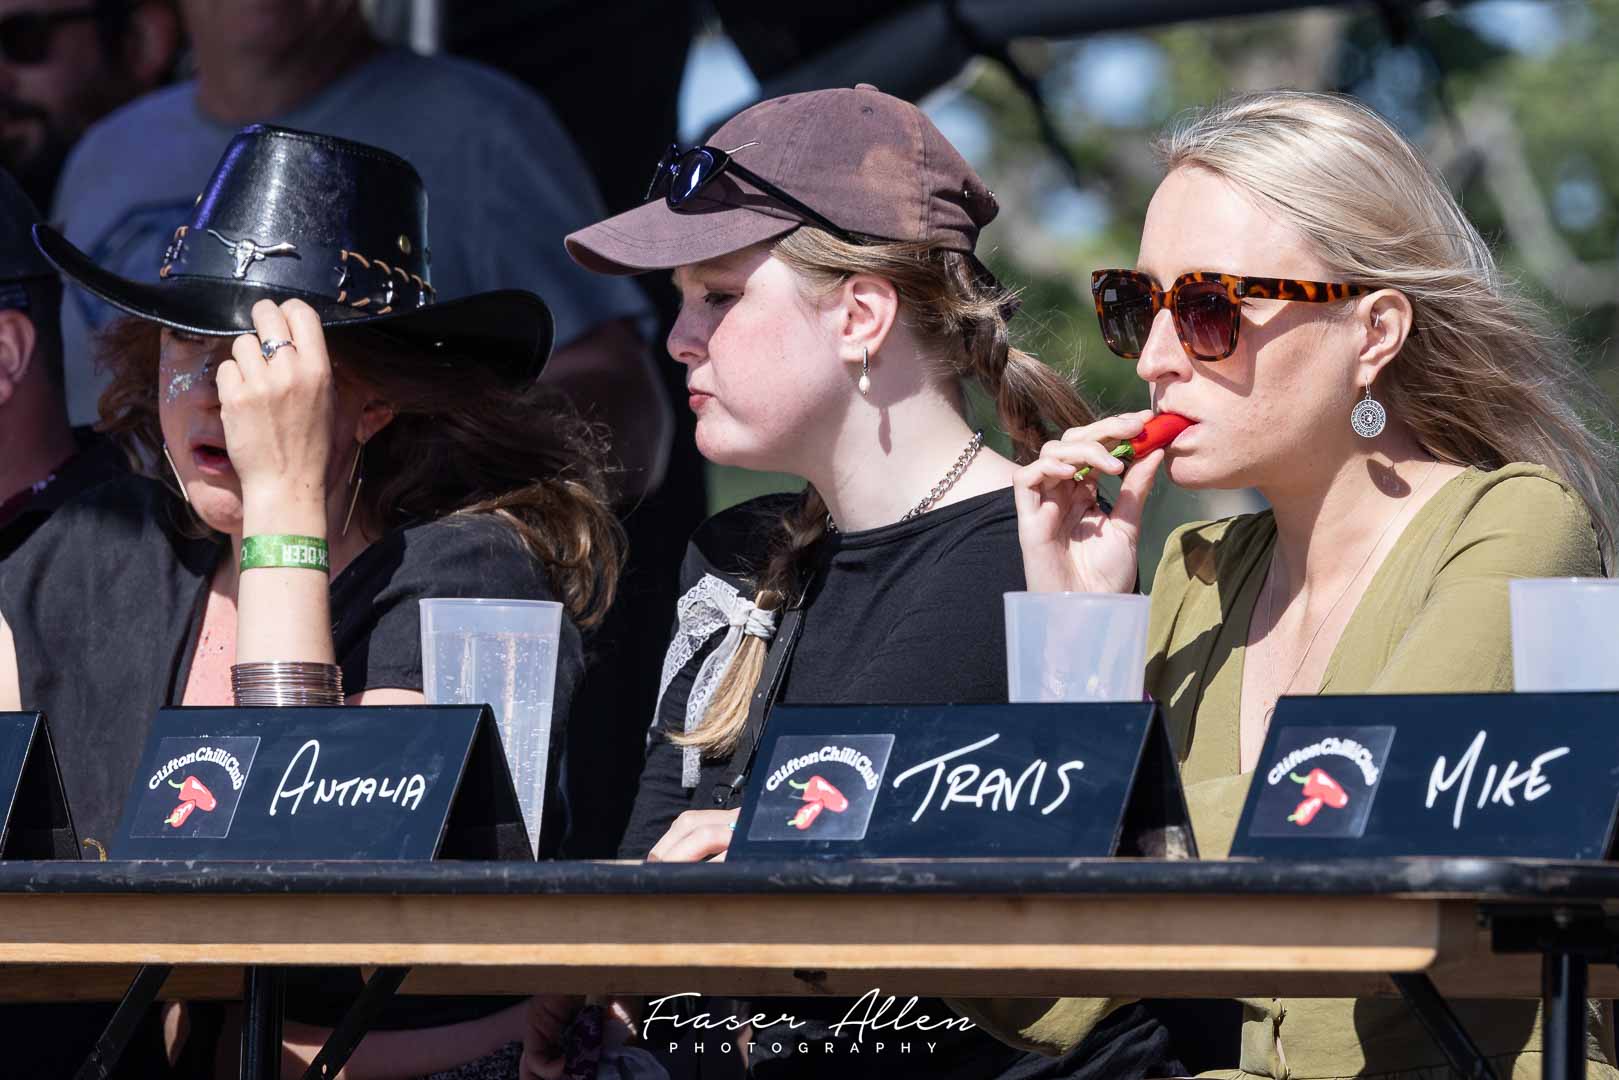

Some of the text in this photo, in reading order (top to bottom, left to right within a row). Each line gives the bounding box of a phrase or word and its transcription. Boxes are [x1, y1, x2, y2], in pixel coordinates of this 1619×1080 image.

[269, 739, 426, 816] ANTALIA
[893, 732, 1085, 823] TRAVIS
[1425, 730, 1571, 830] MIKE
